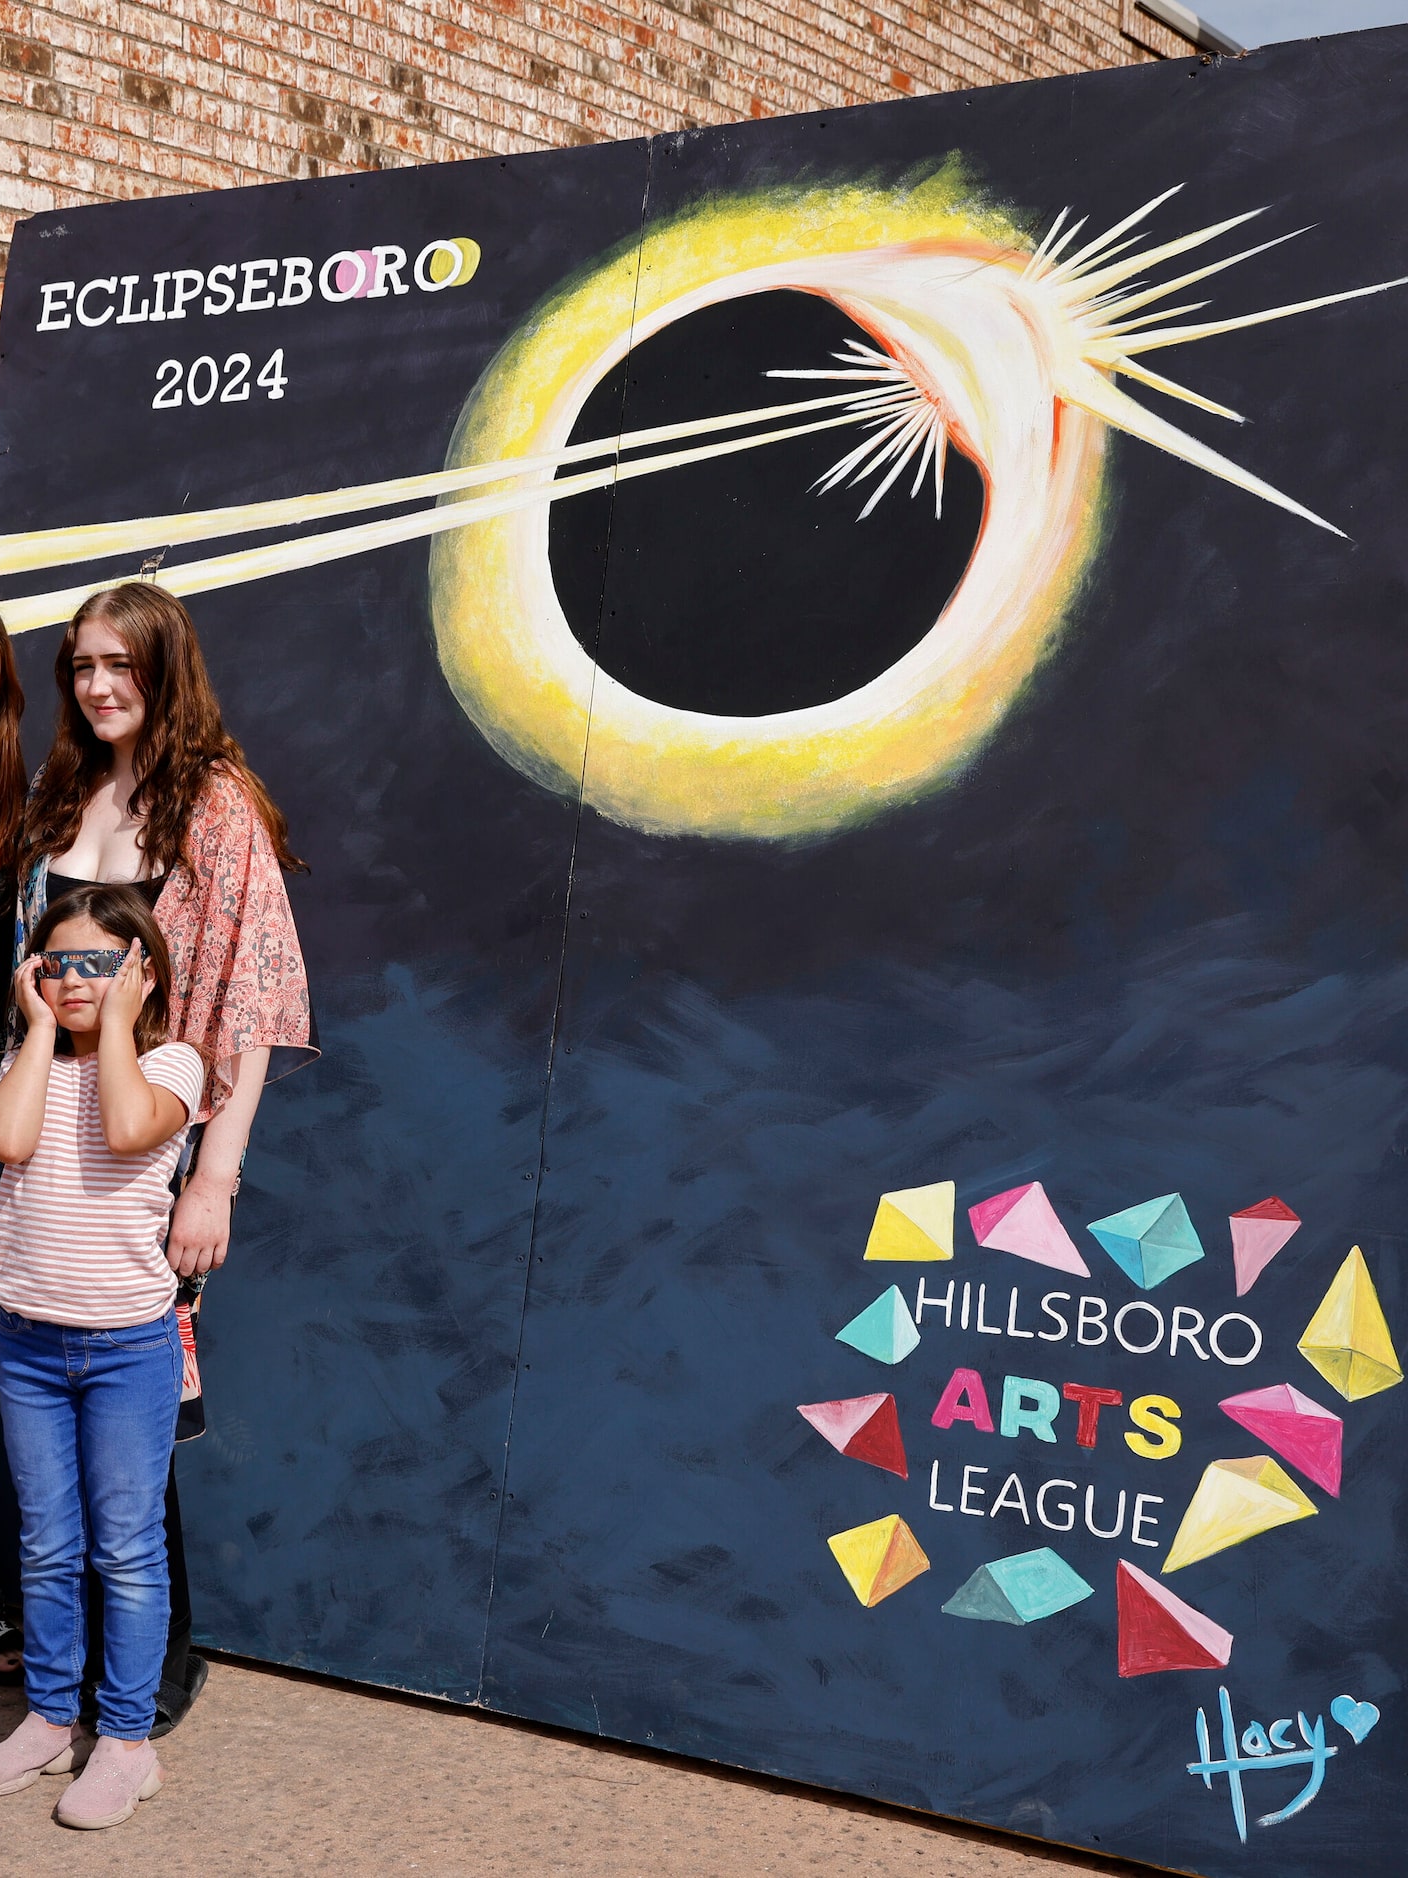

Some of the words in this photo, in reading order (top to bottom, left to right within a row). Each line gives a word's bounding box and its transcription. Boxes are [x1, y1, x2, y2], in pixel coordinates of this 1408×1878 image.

[36, 238, 465, 332] ECLIPSEBORO
[151, 348, 290, 410] 2024
[914, 1276, 1263, 1366] HILLSBORO
[930, 1367, 1184, 1461] ARTS
[928, 1459, 1166, 1549] LEAGUE
